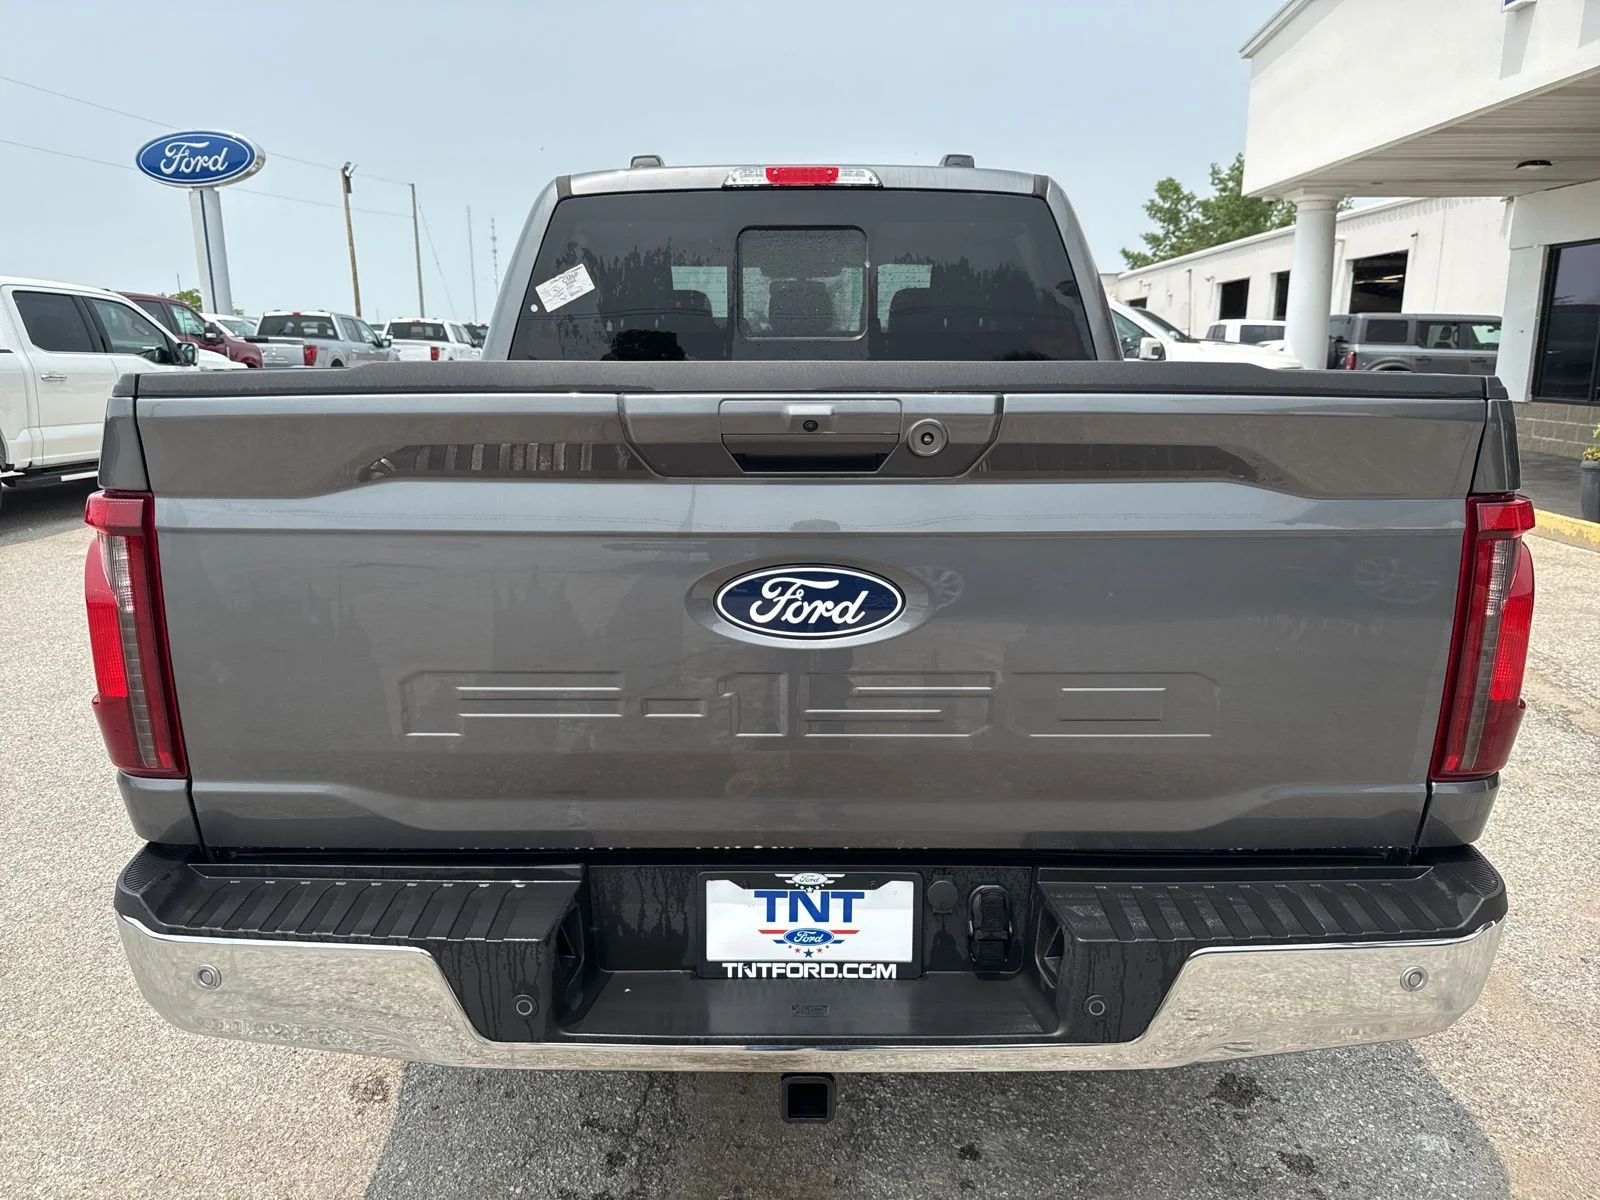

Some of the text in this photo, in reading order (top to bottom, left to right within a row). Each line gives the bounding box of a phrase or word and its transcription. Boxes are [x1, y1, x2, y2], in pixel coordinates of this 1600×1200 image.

[160, 141, 229, 175] Ford
[750, 578, 869, 626] Ford
[401, 670, 1220, 737] F-150
[800, 874, 820, 883] Ford
[754, 891, 865, 923] TNT
[793, 931, 824, 943] Ford
[722, 963, 897, 979] TNTFORD.COM
